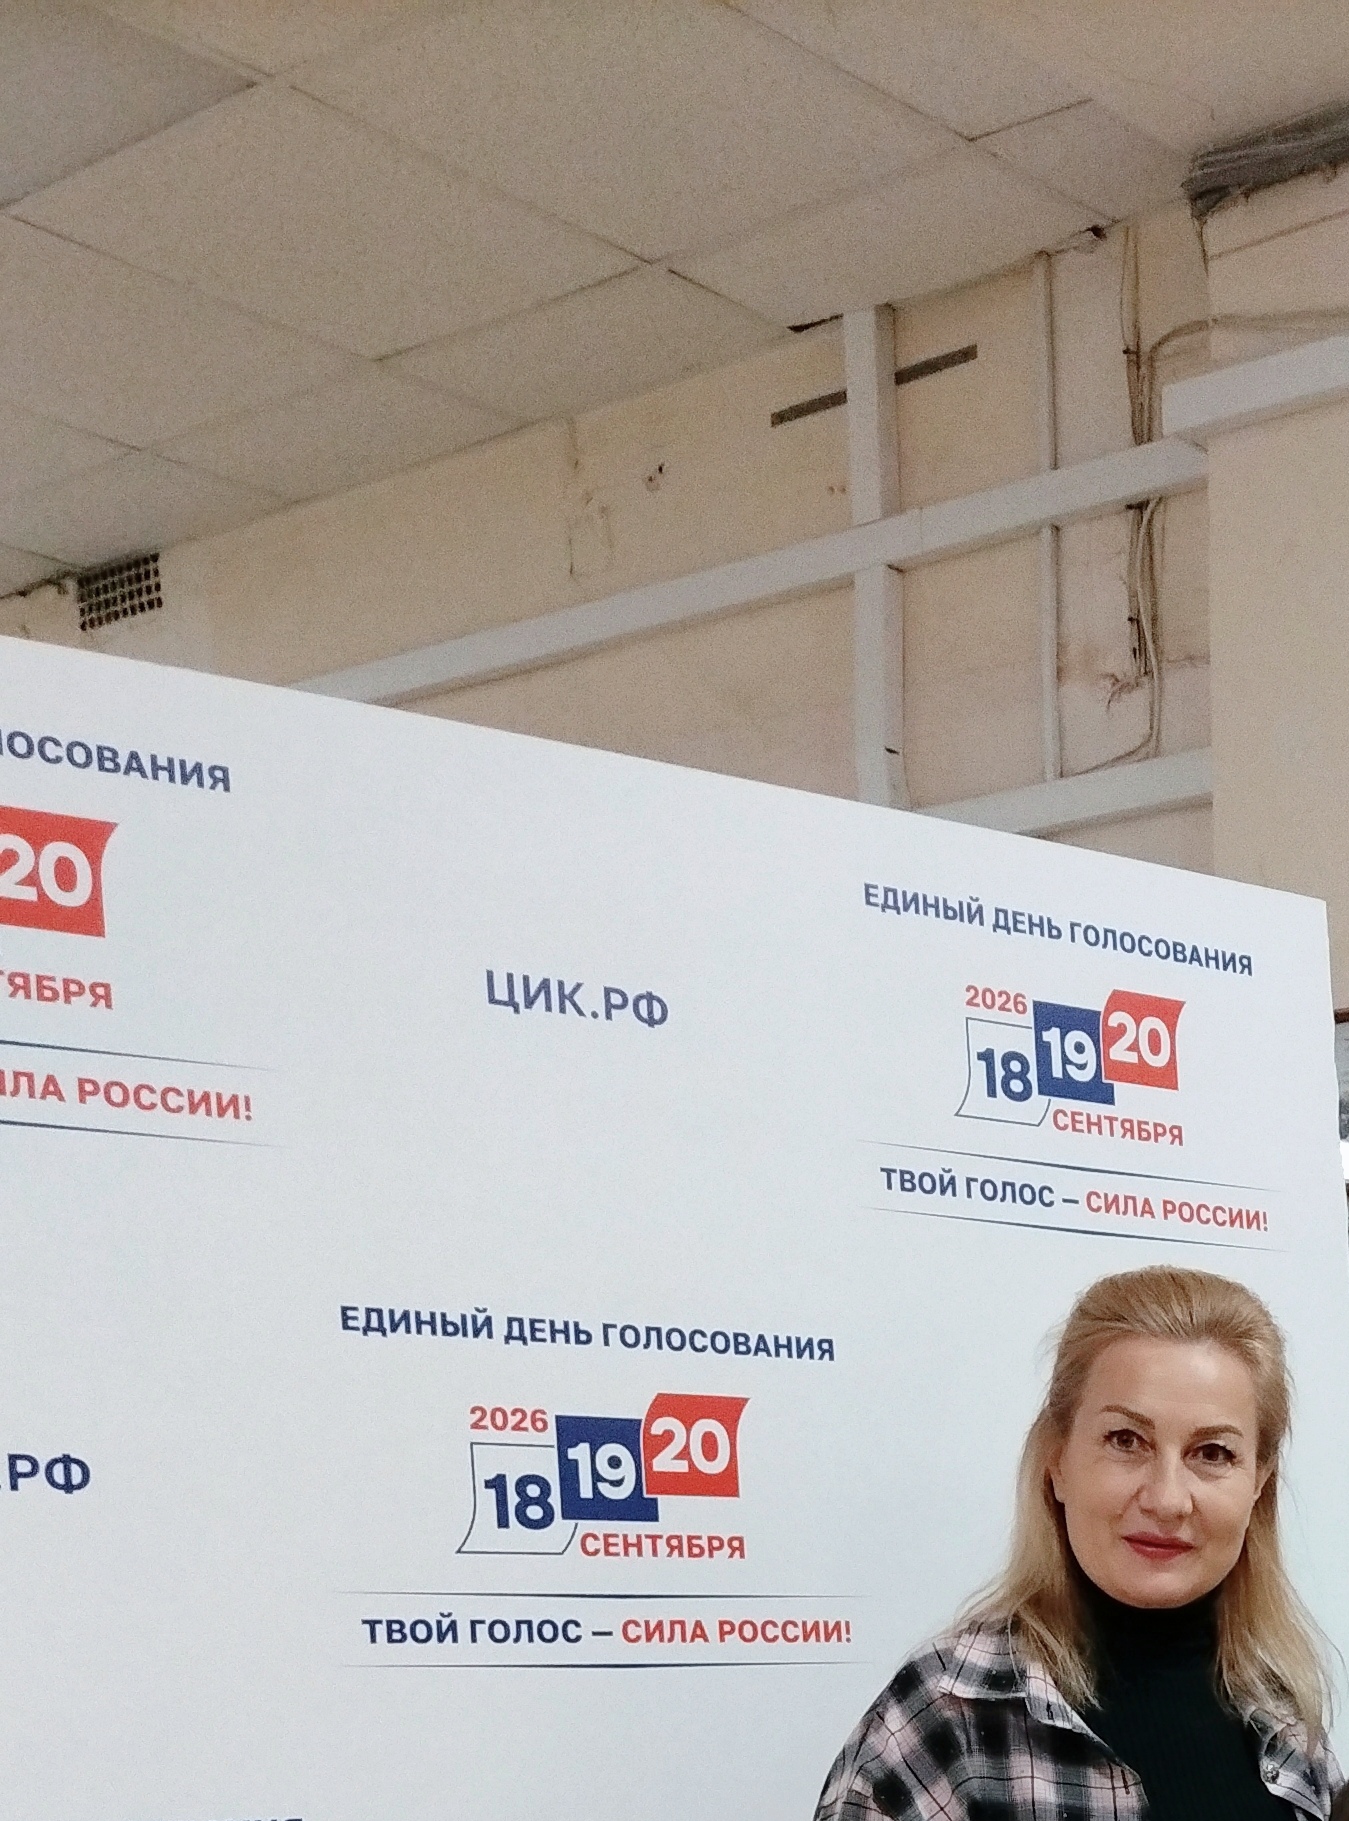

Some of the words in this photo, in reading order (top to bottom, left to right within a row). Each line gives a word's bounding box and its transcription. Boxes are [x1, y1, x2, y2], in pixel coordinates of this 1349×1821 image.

[0, 833, 93, 908] 20
[864, 882, 985, 927] ЕДИНЫЙ
[992, 907, 1063, 940] ДЕНЬ
[1069, 921, 1253, 977] ГОЛОСОВАНИЯ
[486, 969, 669, 1029] ЦИК.РФ
[965, 984, 1028, 1015] 2026
[974, 1047, 1032, 1103] 18
[1040, 1026, 1097, 1083] 19
[1107, 1012, 1171, 1068] 20
[77, 1077, 252, 1121] РОССИИ!
[1052, 1108, 1184, 1147] СЕНТЯБРЯ
[878, 1166, 959, 1200] ТВОЙ
[965, 1176, 1055, 1208] ГОЛОС
[1085, 1190, 1156, 1219] СИЛА
[1162, 1199, 1268, 1232] РОССИИ!
[340, 1305, 494, 1340] ЕДИНЫЙ
[503, 1316, 593, 1346] ДЕНЬ
[602, 1322, 835, 1362] ГОЛОСОВАНИЯ
[469, 1405, 549, 1433] 2026
[7, 1453, 91, 1494] РФ
[484, 1473, 556, 1530] 18
[566, 1441, 637, 1500] 19
[650, 1418, 730, 1474] 20
[580, 1532, 746, 1559] СЕНТЯБРЯ
[361, 1612, 459, 1644] ТВОЙ
[469, 1619, 582, 1644] ГОЛОС
[621, 1619, 710, 1644] СИЛА
[718, 1619, 851, 1644] РОССИИ!
